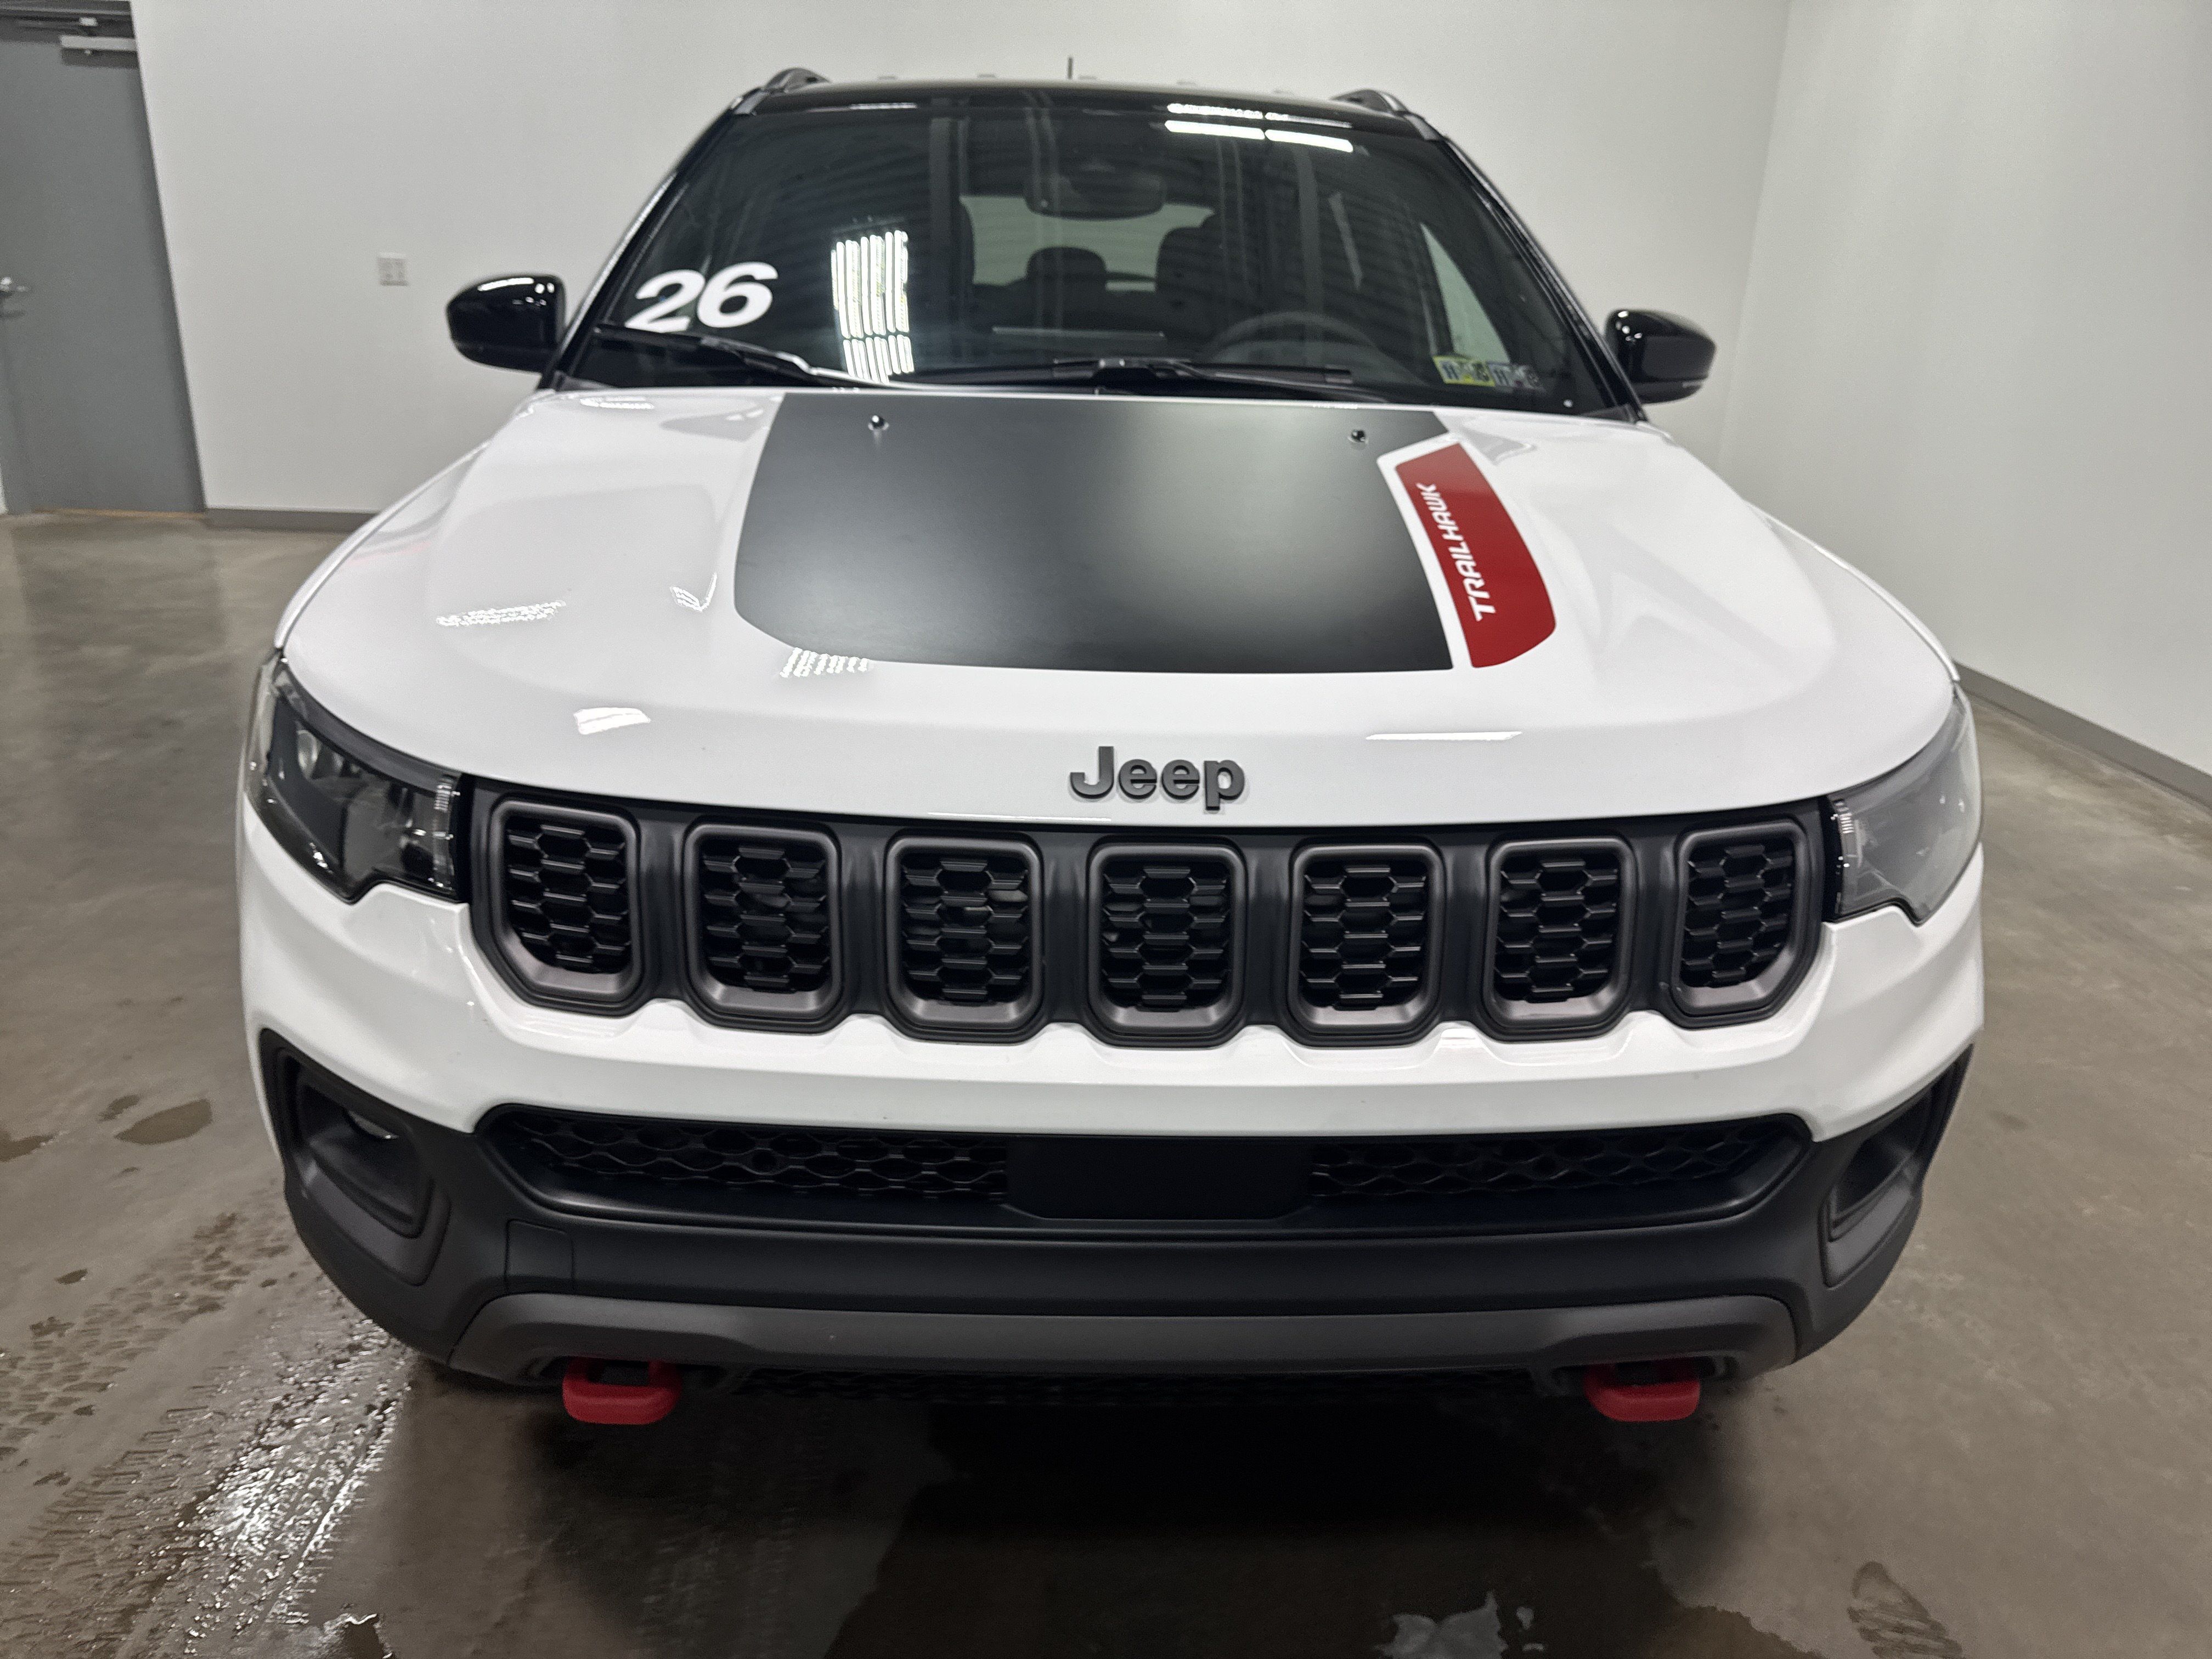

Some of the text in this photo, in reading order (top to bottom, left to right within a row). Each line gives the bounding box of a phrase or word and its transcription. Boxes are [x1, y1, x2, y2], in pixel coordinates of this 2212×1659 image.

[624, 261, 779, 333] 26
[1416, 483, 1497, 622] TRAILHAWK
[1070, 746, 1245, 811] Jeep
